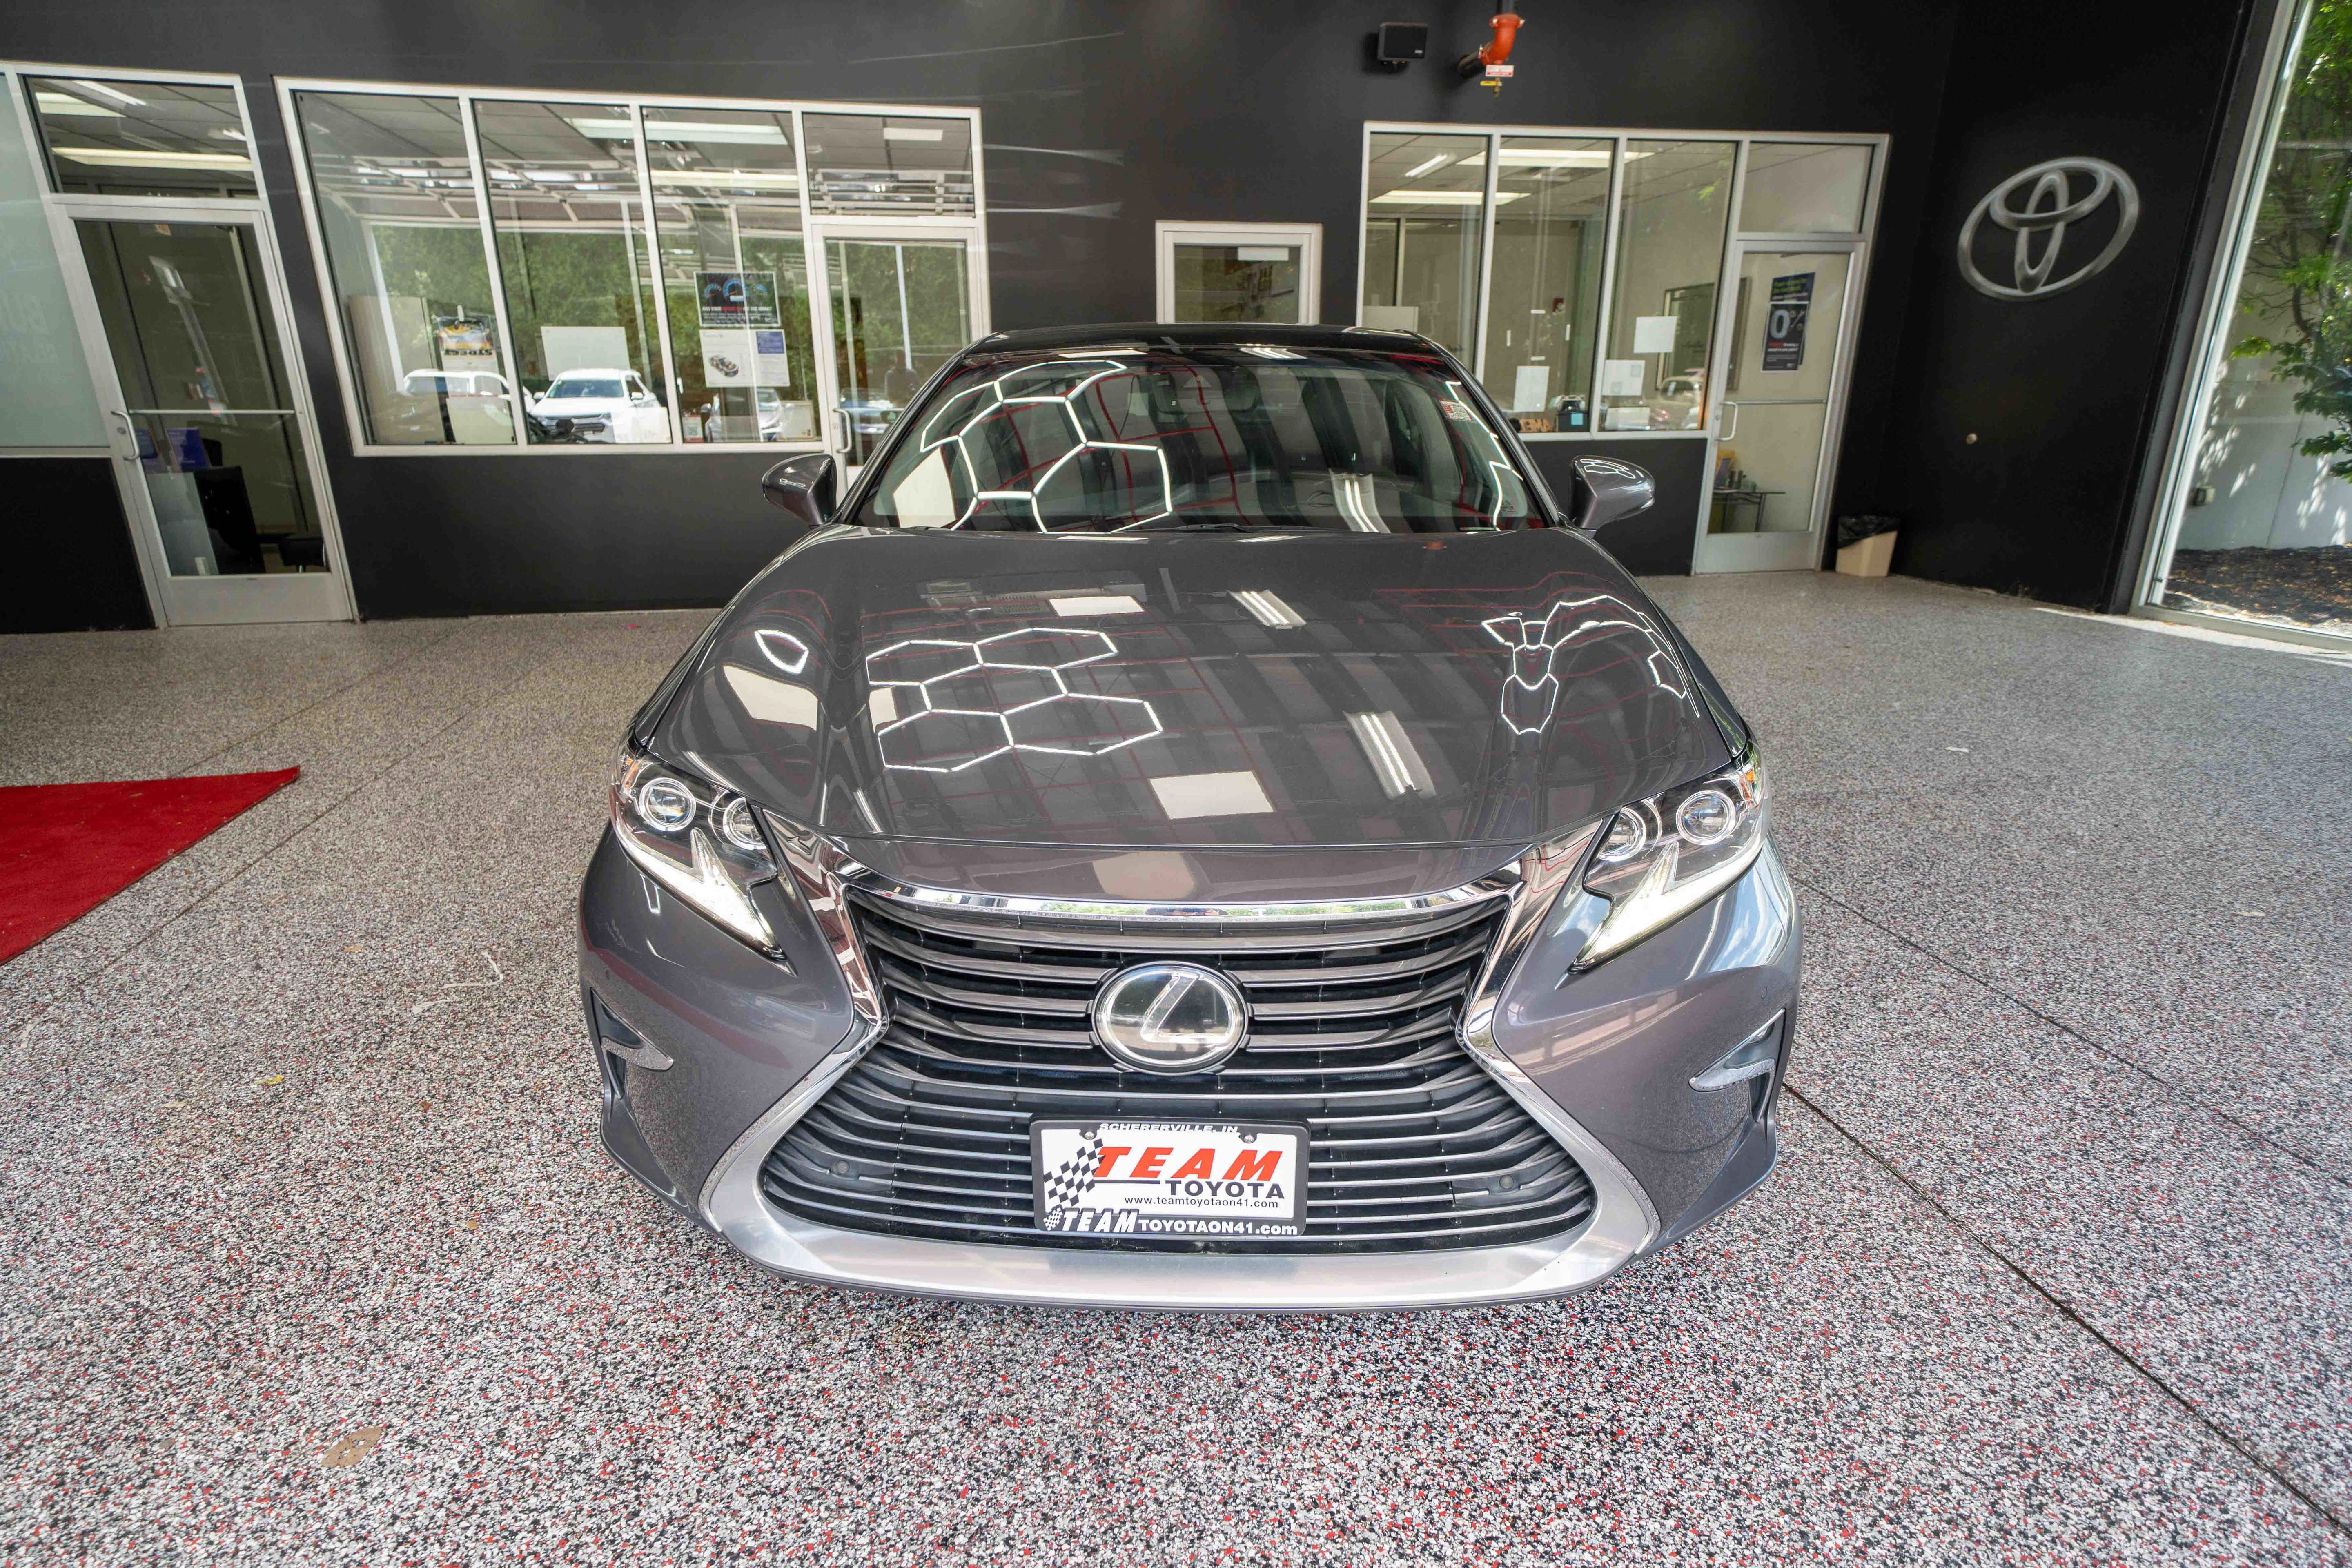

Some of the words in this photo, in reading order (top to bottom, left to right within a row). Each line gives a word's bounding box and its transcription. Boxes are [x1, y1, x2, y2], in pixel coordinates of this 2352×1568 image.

[1093, 1147, 1283, 1181] TEAM
[1166, 1180, 1285, 1199] TOYOTA
[1125, 1196, 1278, 1208] www.teamtoyotaon41.com
